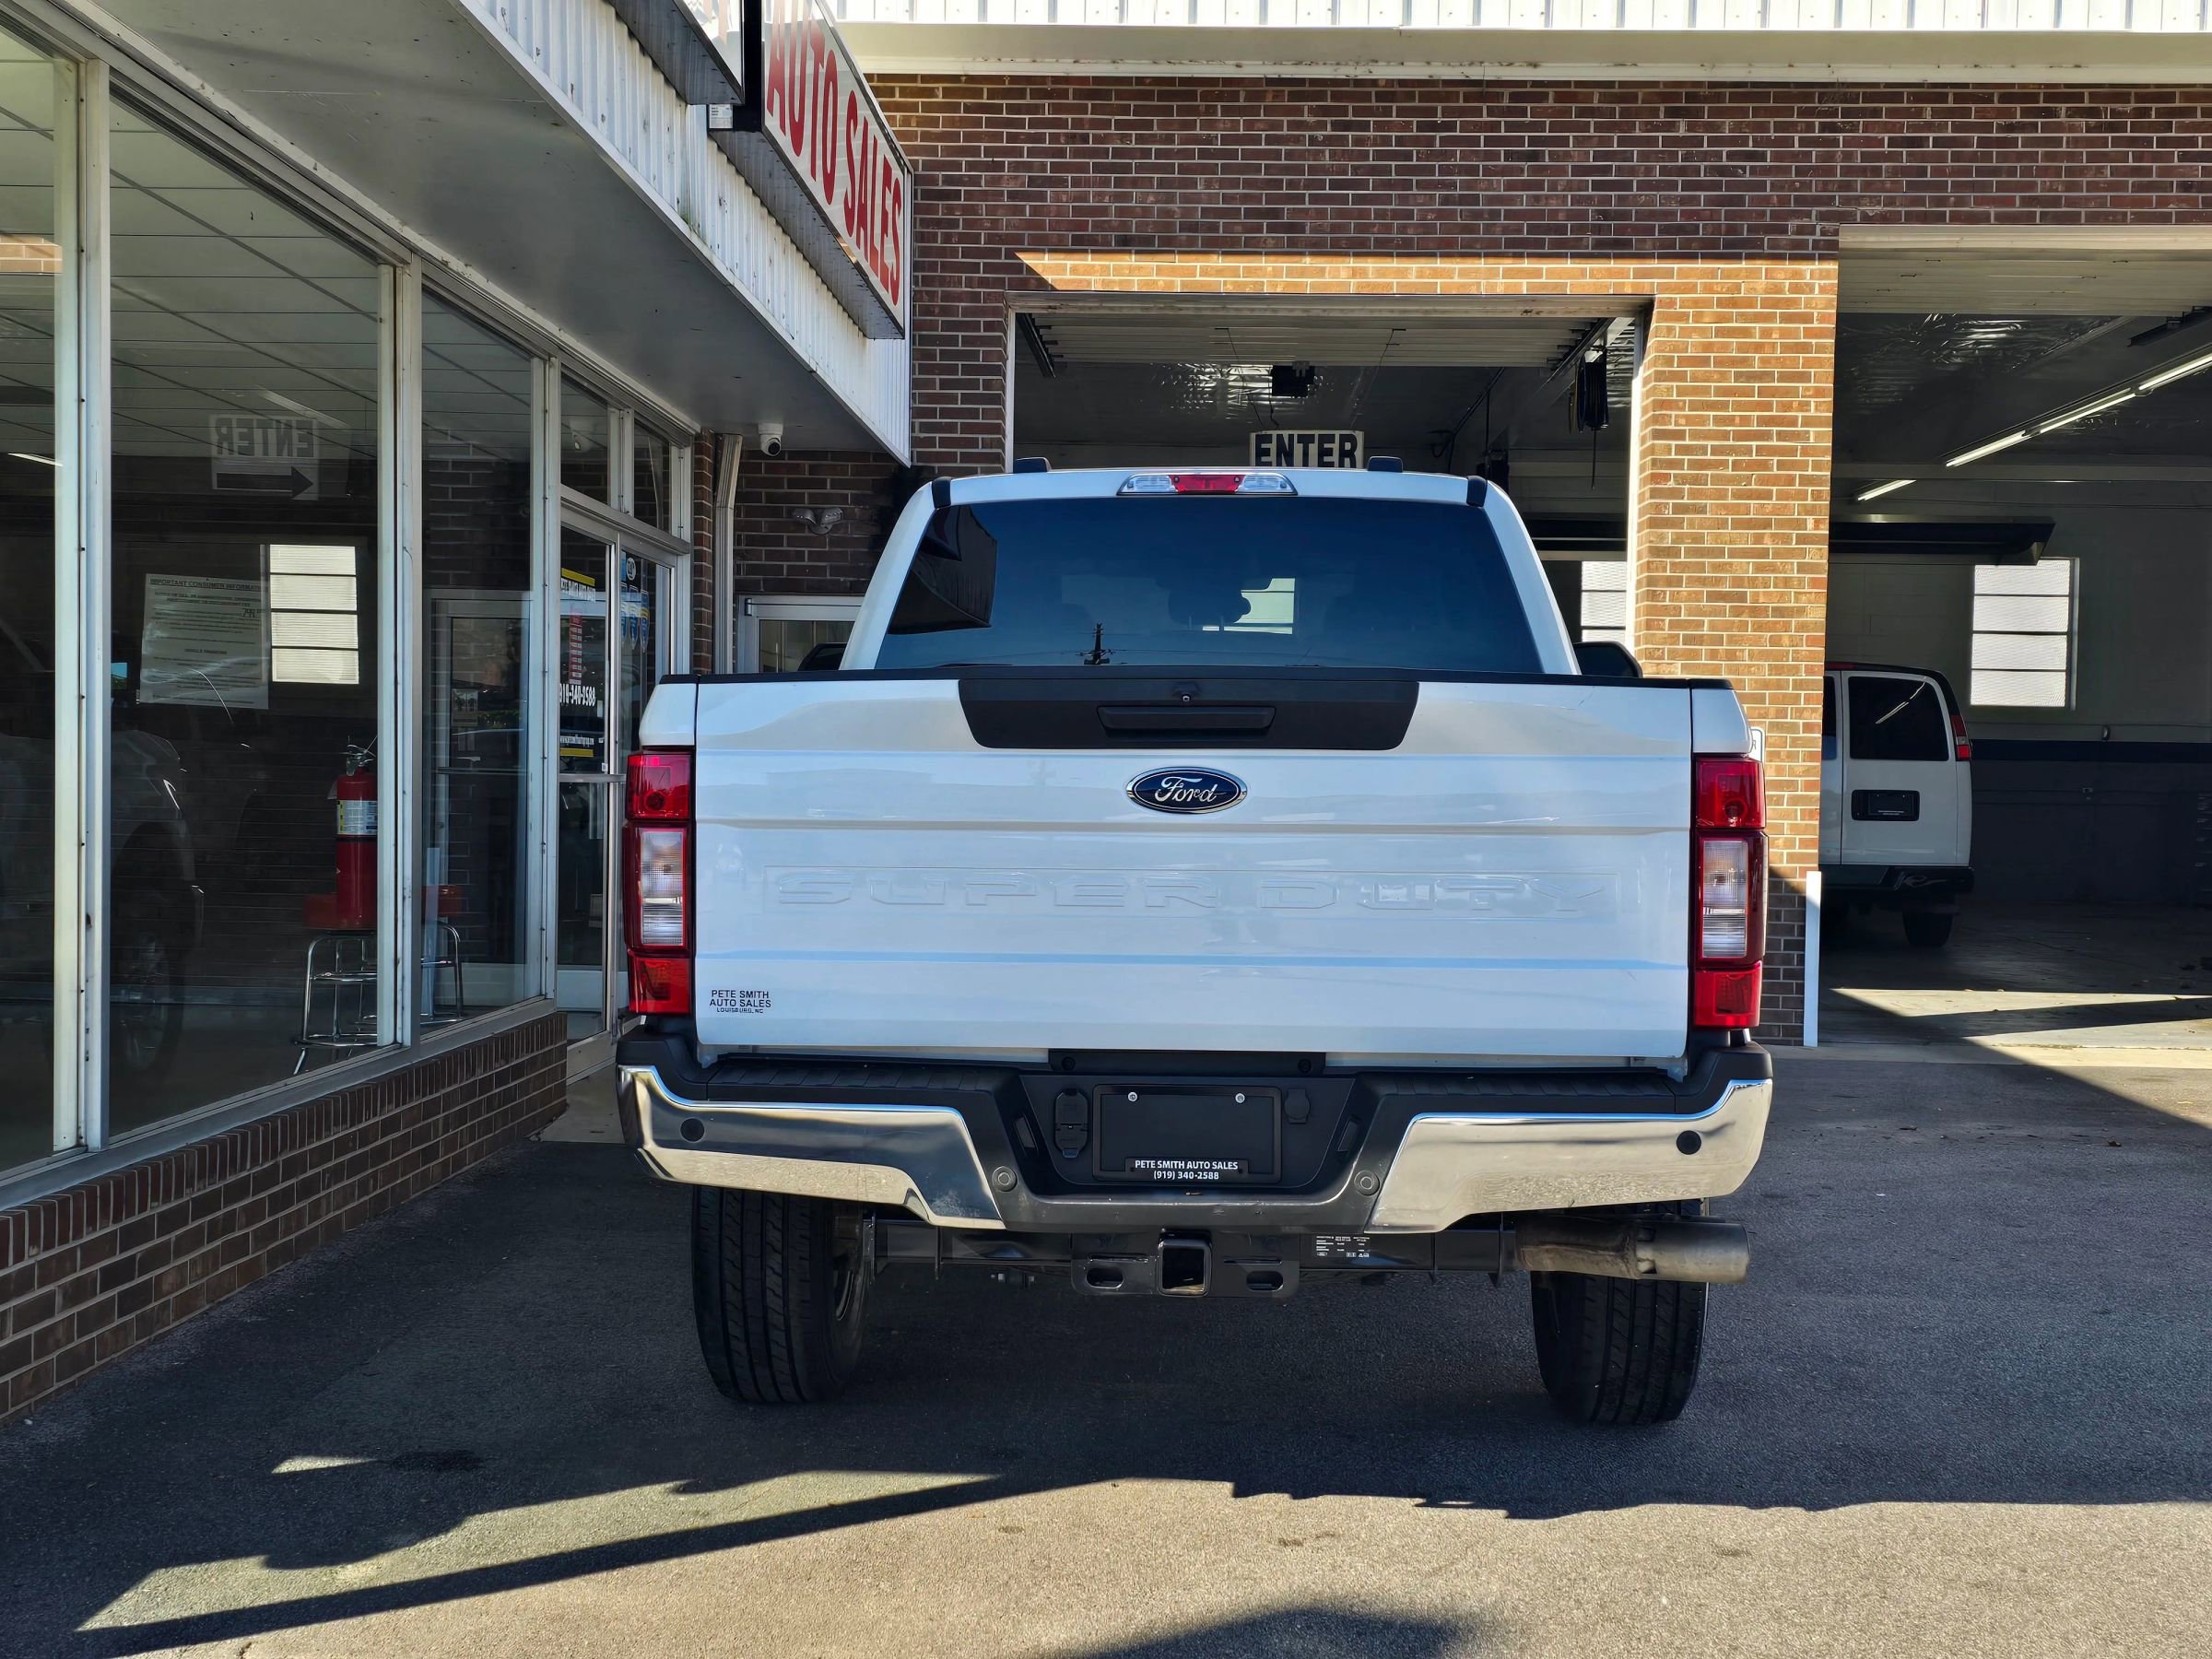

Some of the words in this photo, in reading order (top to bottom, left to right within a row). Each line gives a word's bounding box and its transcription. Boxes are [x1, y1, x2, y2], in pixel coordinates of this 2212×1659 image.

[767, 0, 838, 205] AUTO
[844, 90, 902, 306] SALES
[1254, 433, 1358, 468] ENTER
[1155, 776, 1227, 802] Ford
[777, 873, 1218, 910] SUPER
[1258, 876, 1606, 914] DUTY
[712, 990, 736, 998] PETE
[739, 990, 769, 998] SMITH
[739, 999, 771, 1007] SALES
[1135, 1160, 1156, 1169] PETE
[1158, 1160, 1185, 1169] SMITH
[1186, 1161, 1211, 1170] AUTO
[1212, 1161, 1239, 1170] SALES
[1154, 1171, 1175, 1180] (919)
[1178, 1171, 1219, 1180] 340-2588
